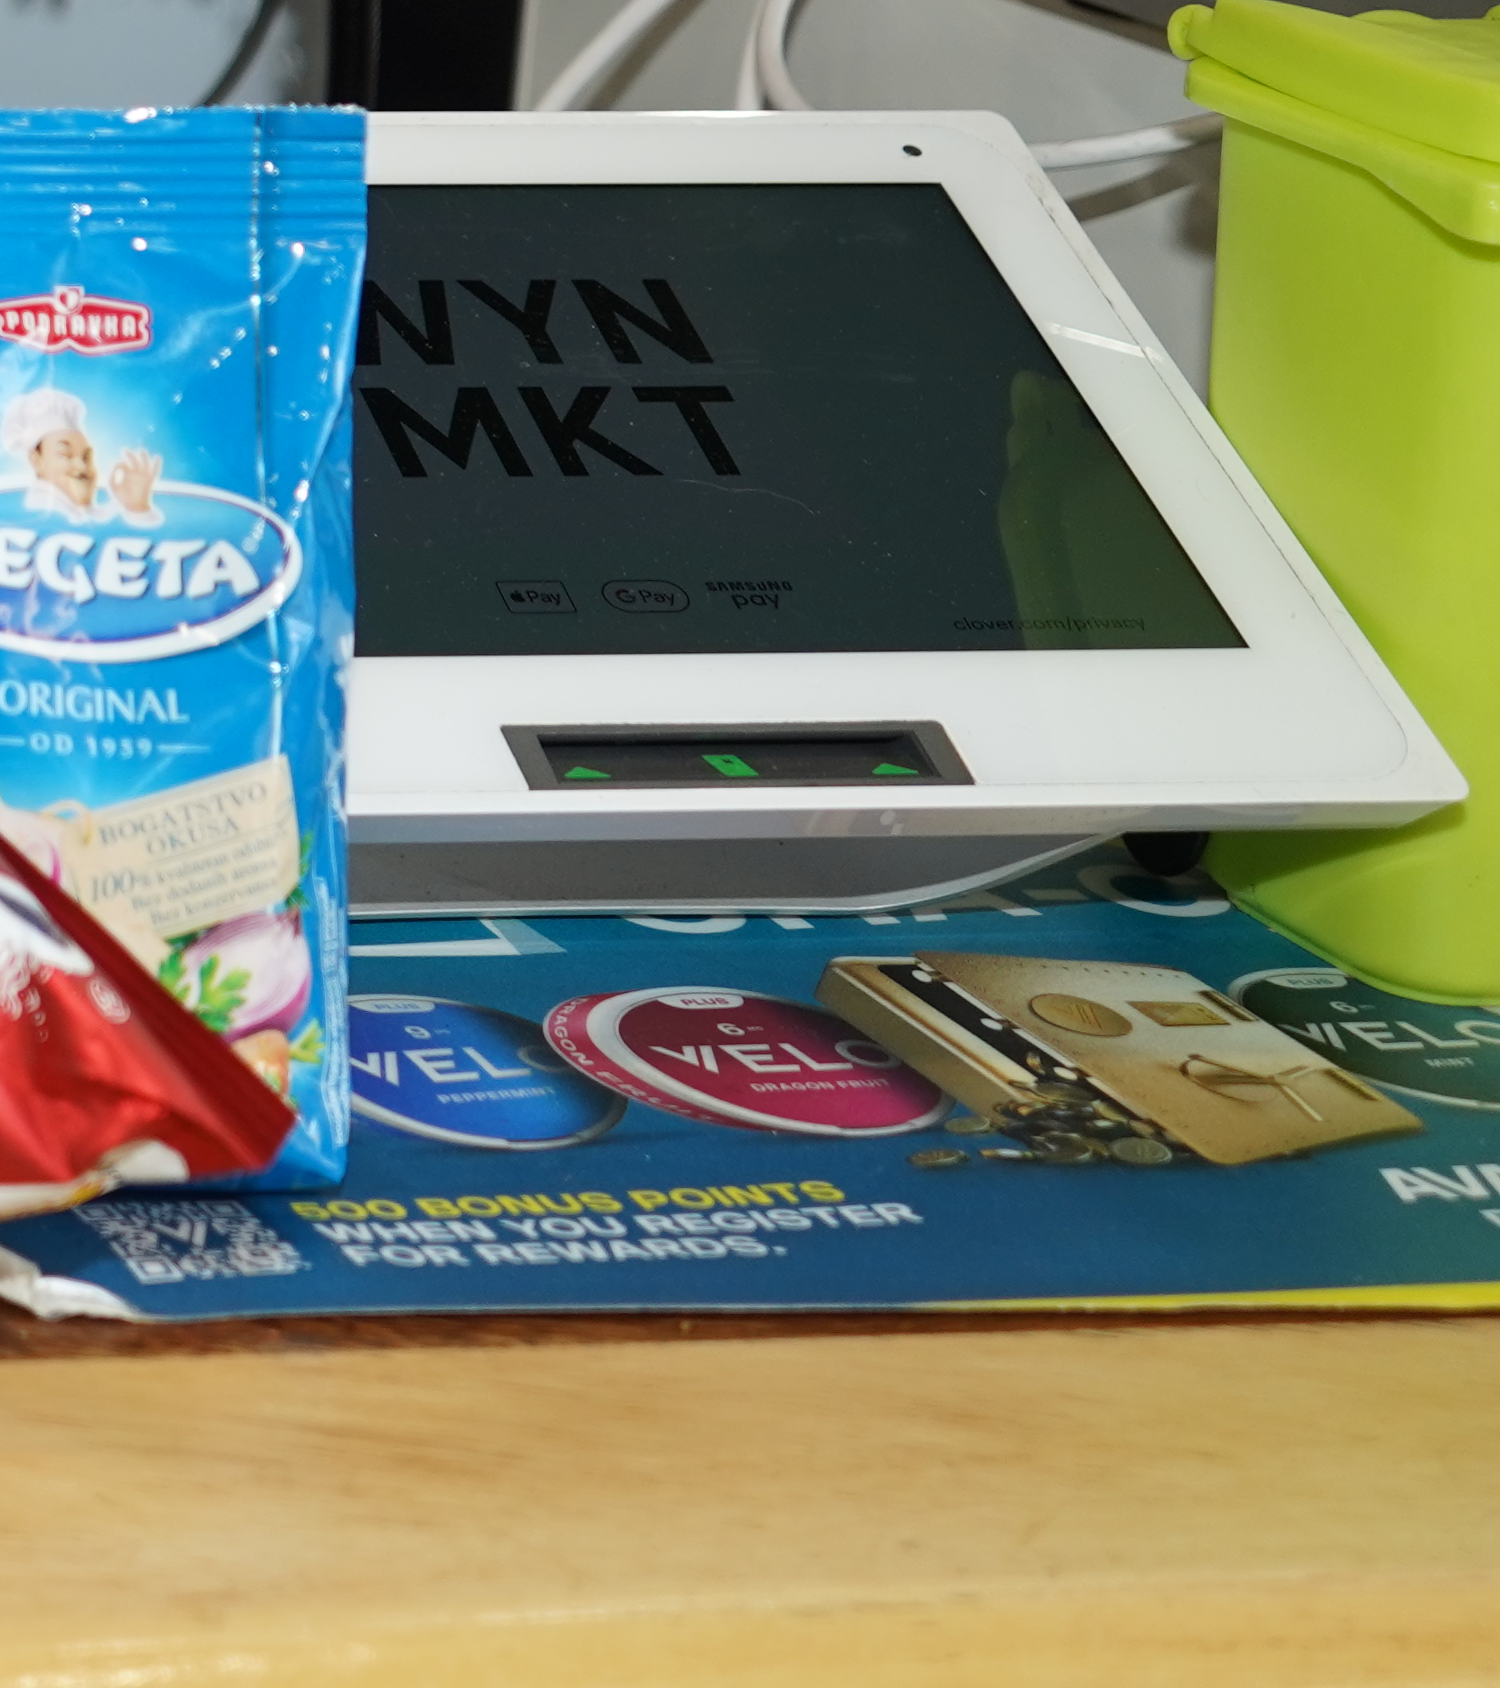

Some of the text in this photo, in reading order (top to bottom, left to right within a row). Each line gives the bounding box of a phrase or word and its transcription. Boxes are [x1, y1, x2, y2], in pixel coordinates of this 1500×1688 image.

[358, 385, 742, 478] MKT
[704, 580, 793, 592] SAMSUNG
[527, 588, 562, 608] Pay
[639, 588, 677, 609] Pay
[731, 591, 780, 611] pay
[952, 616, 1146, 633] clover.com/privacy
[29, 732, 74, 755] OD
[1285, 977, 1334, 986] PLUS
[679, 994, 731, 1008] PLUS
[716, 1022, 746, 1037] 6
[648, 1039, 904, 1075] VELO
[436, 1085, 556, 1105] PEPPERMINT
[750, 1077, 892, 1093] DRAGON FRUIT
[291, 1179, 845, 1221] 500 BONUS POINTS
[311, 1199, 924, 1246] WHEN YOU REGISTER
[337, 1231, 788, 1272] FOR REWARDS.
